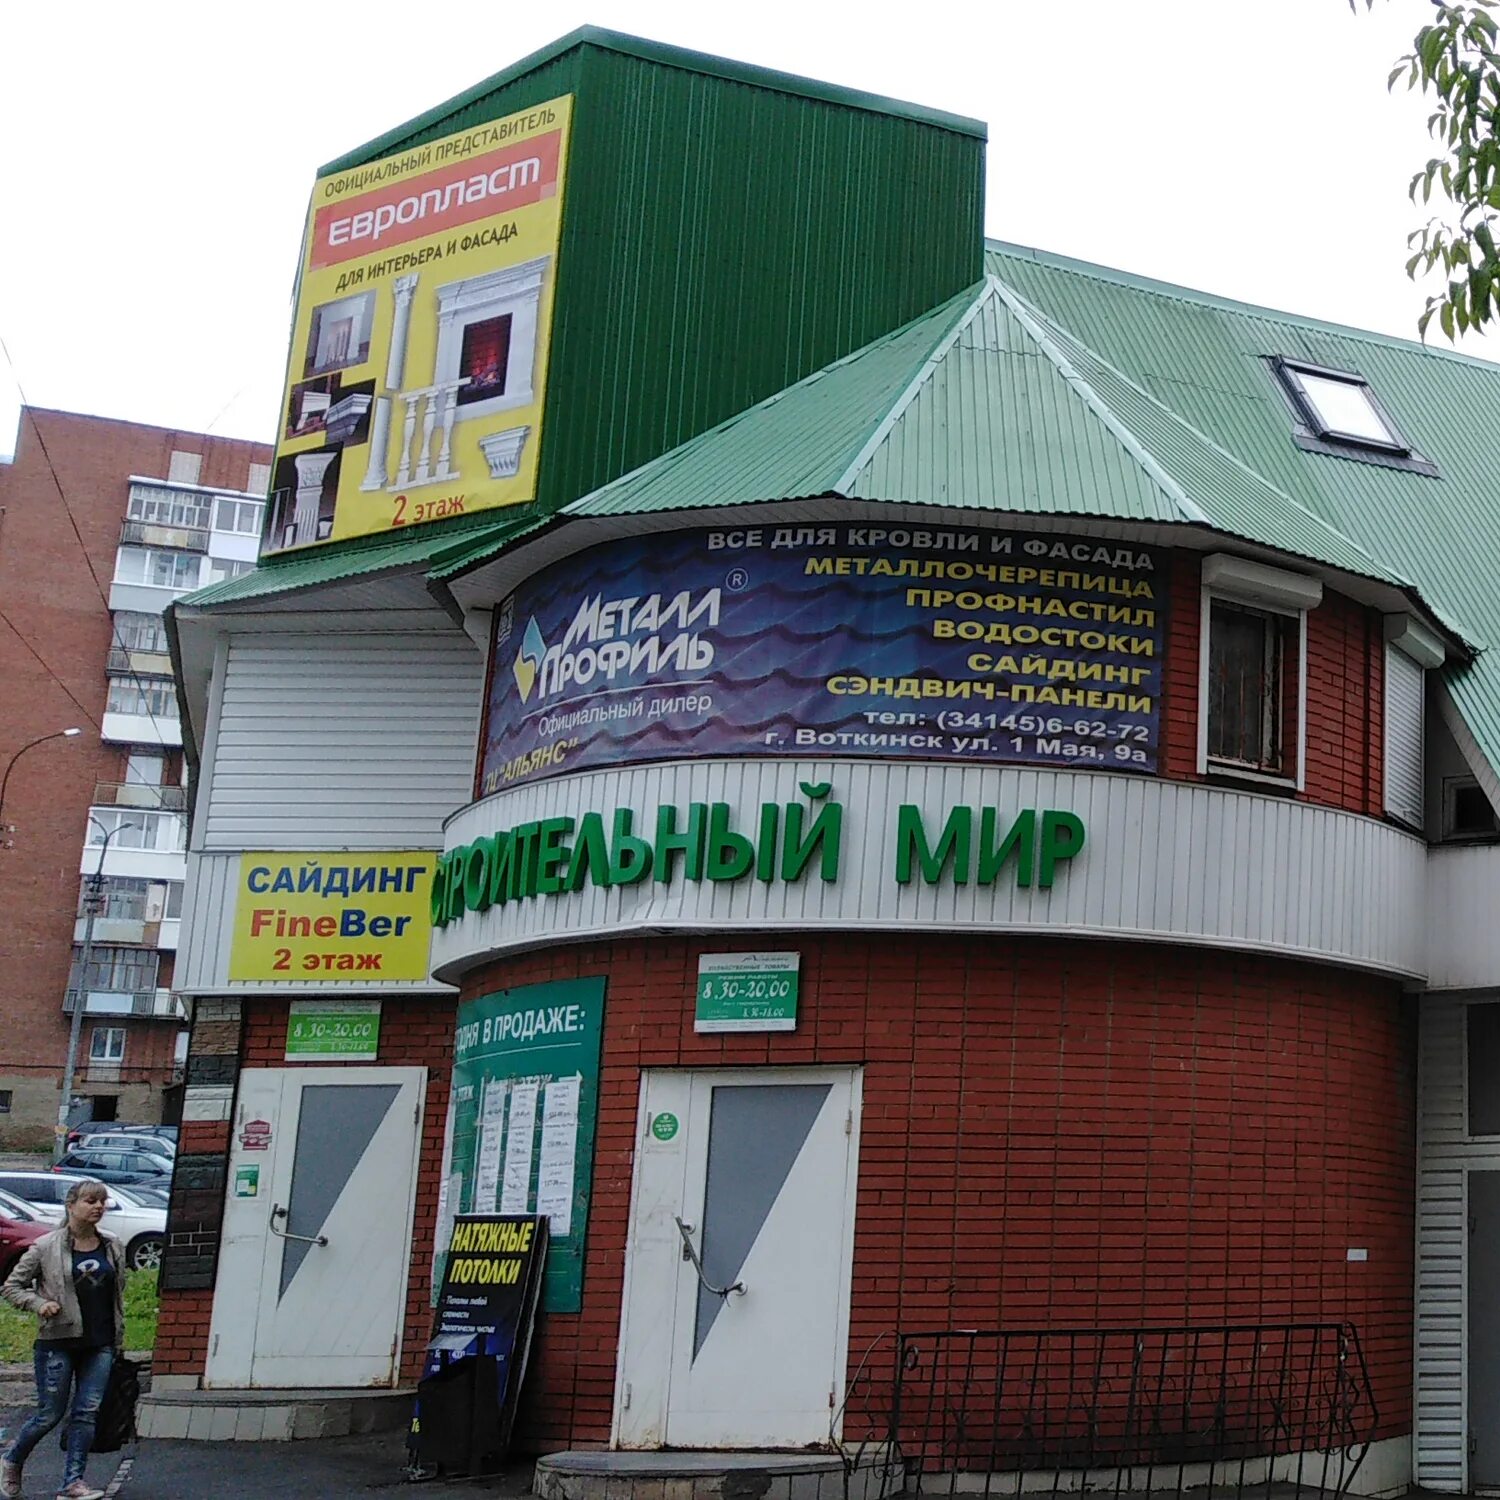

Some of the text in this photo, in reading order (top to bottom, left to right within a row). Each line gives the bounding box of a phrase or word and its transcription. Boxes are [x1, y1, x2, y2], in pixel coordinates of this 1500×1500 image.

[325, 108, 556, 198] ОФИЦИАЛЬНЫЙ ПРЕДСТАВИТЕЛЬ
[335, 221, 518, 293] ДЛЯ ИНТЕРЬЕРА И ФАСАДА
[392, 493, 465, 526] 2 этаж
[708, 528, 1154, 571] ВСЕ ДЛЯ КРОВЛИ И ФАСАДА
[804, 556, 1154, 600] МЕТАЛЛОЧЕРЕПИЦА
[906, 588, 1156, 628] ПРОФНАСТИЛ
[932, 618, 1155, 657] ВОДОСТОКИ
[967, 650, 1153, 687] САЙДИНГ
[825, 674, 1152, 714] СЭНДВИЧ-ПАНЕЛИ
[538, 694, 713, 737] Официальный дилер
[863, 709, 1150, 743] тел: (34145)6-62-72
[764, 728, 1148, 763] г. Воткинск ул. 1 Мая, 9а
[430, 781, 1085, 928] СТРОИТЕЛЬНЫЙ МИР
[247, 861, 426, 898] САЙДИНГ
[250, 909, 411, 938] FineBer
[273, 948, 382, 971] 2 этаж
[702, 980, 790, 1000] 8.30-20.00
[483, 1019, 493, 1045] В
[493, 1003, 586, 1042] ПРОДАЖЕ:
[450, 1222, 534, 1253] НАТЯЖНЫЕ
[449, 1258, 522, 1285] ПОТОЛКИ
